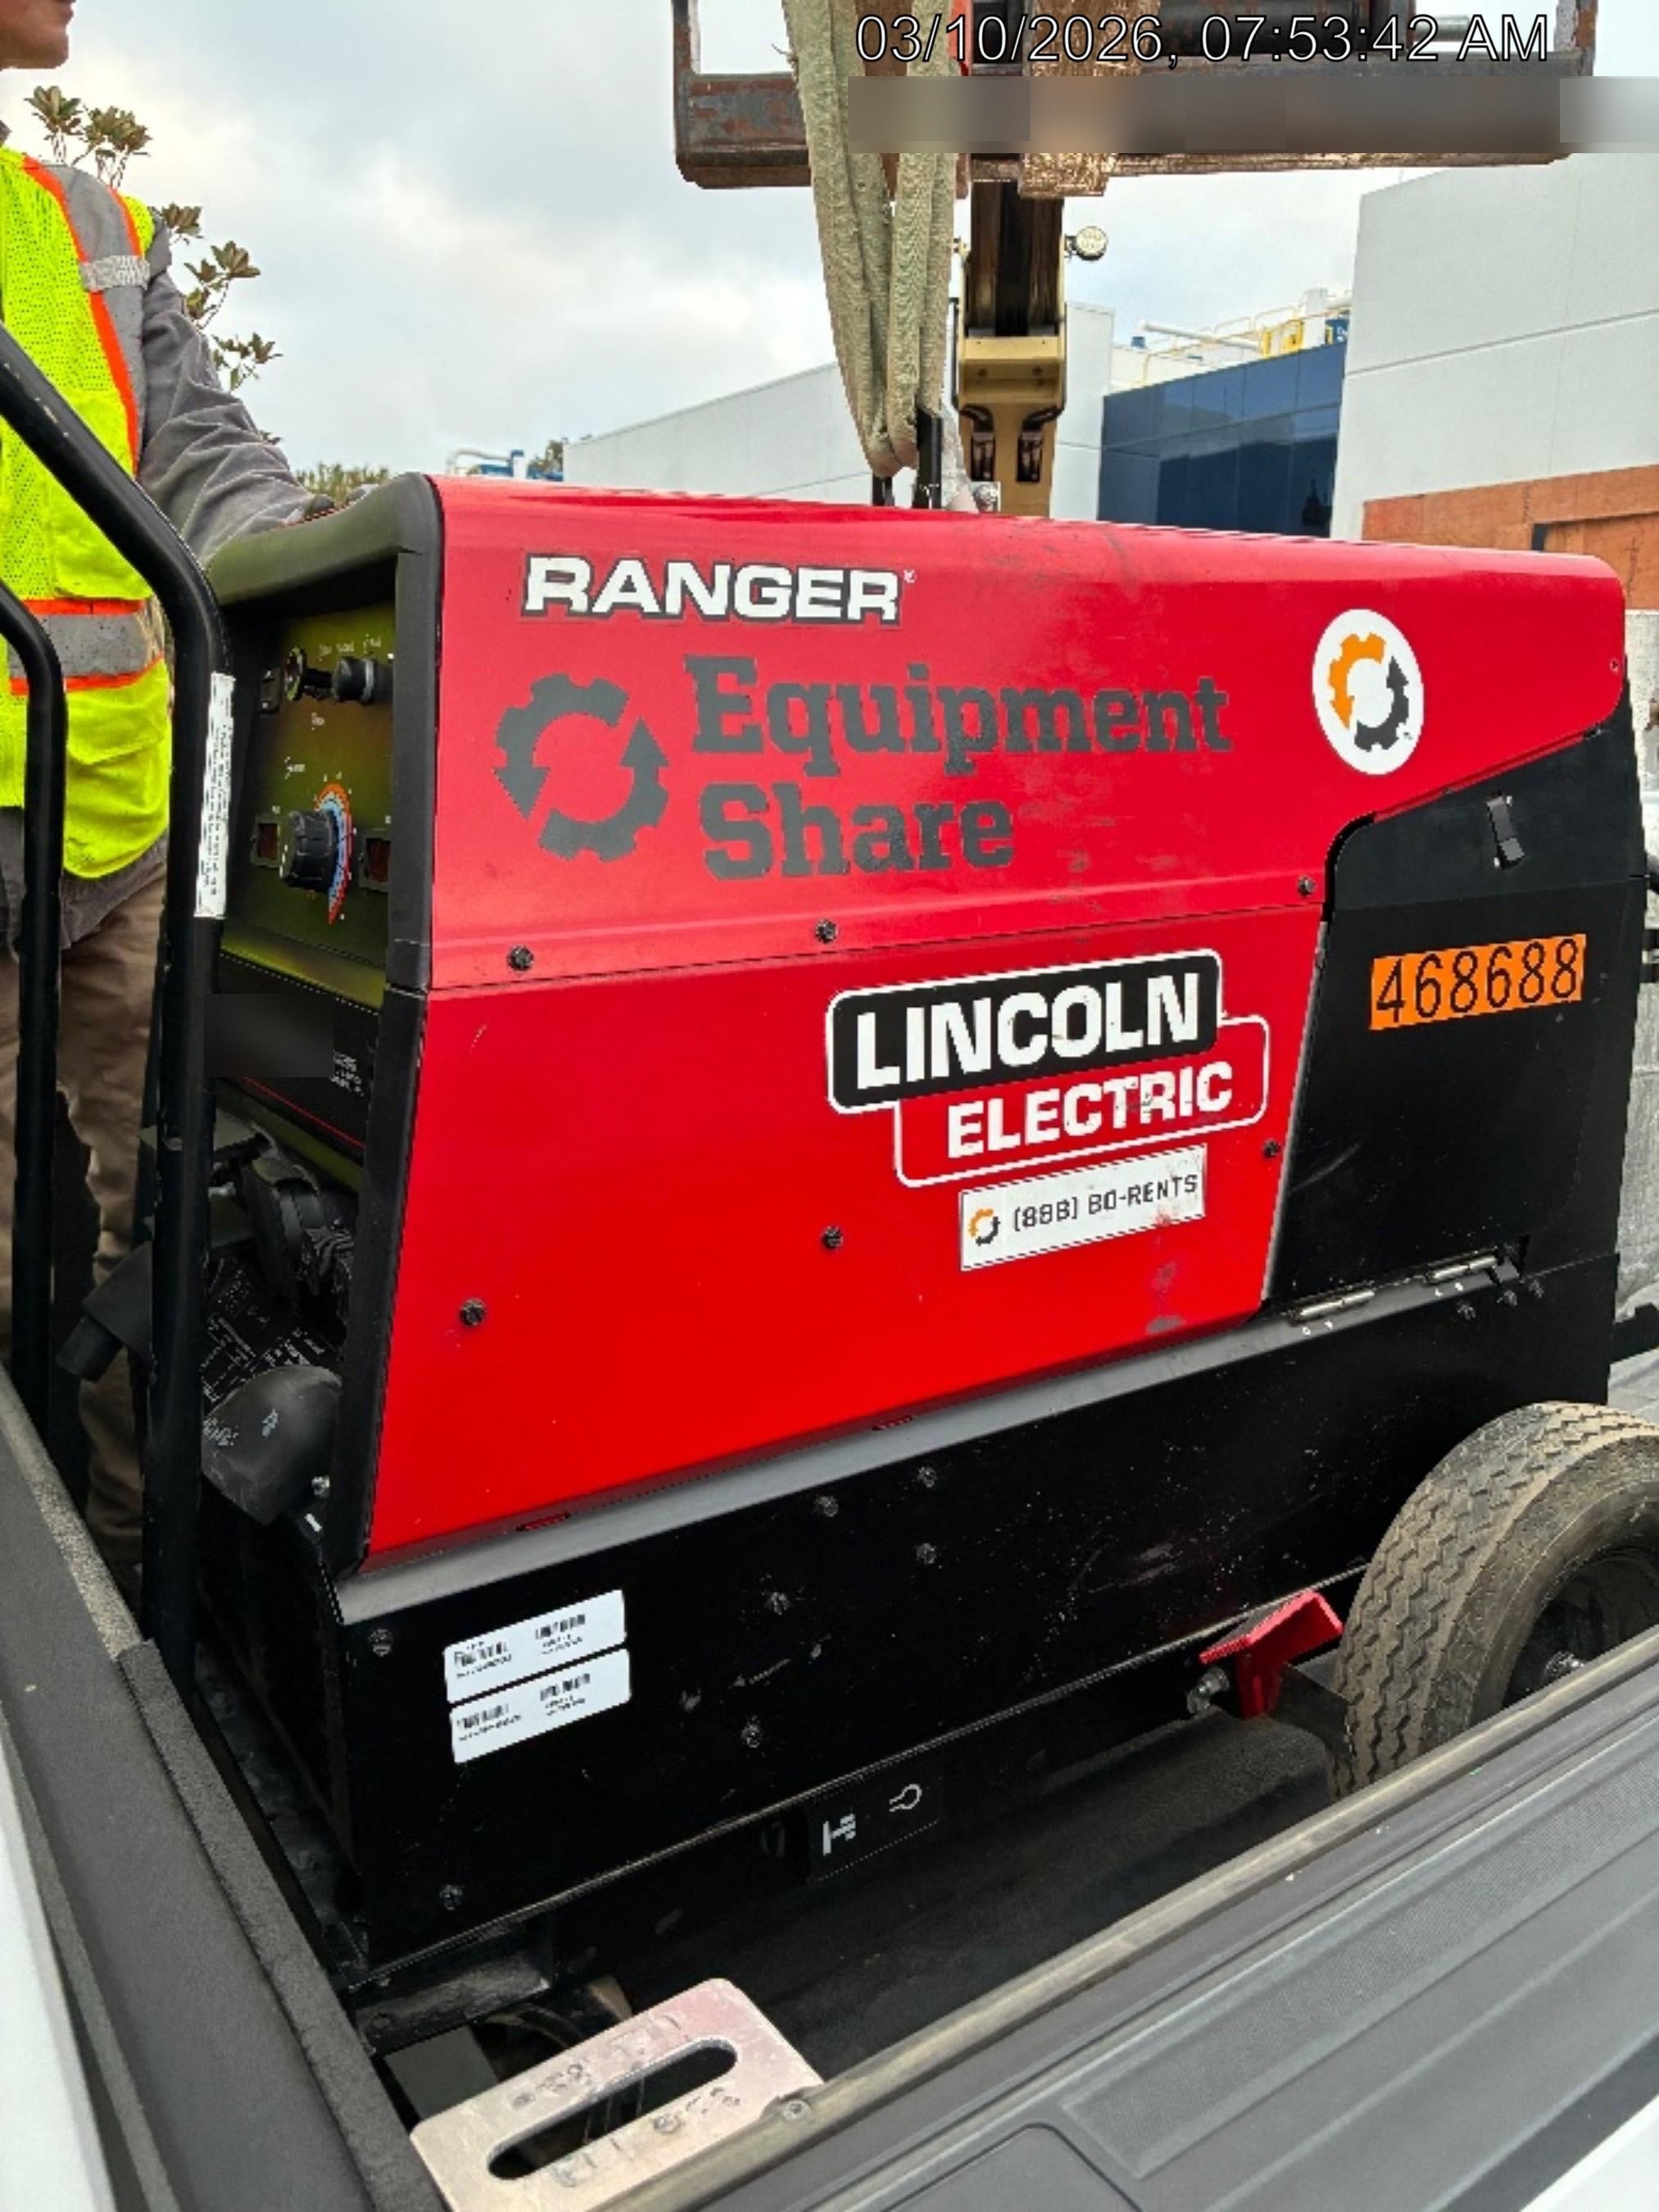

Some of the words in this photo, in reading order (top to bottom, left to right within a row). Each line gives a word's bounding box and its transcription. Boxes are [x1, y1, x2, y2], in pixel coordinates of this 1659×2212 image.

[522, 554, 900, 624] RANGER
[683, 654, 1232, 777] Equipment
[699, 782, 1015, 881] Share
[1376, 938, 1578, 1023] 468688
[857, 972, 1199, 1090] LINCOLN
[948, 1062, 1233, 1158] ELECTRIC
